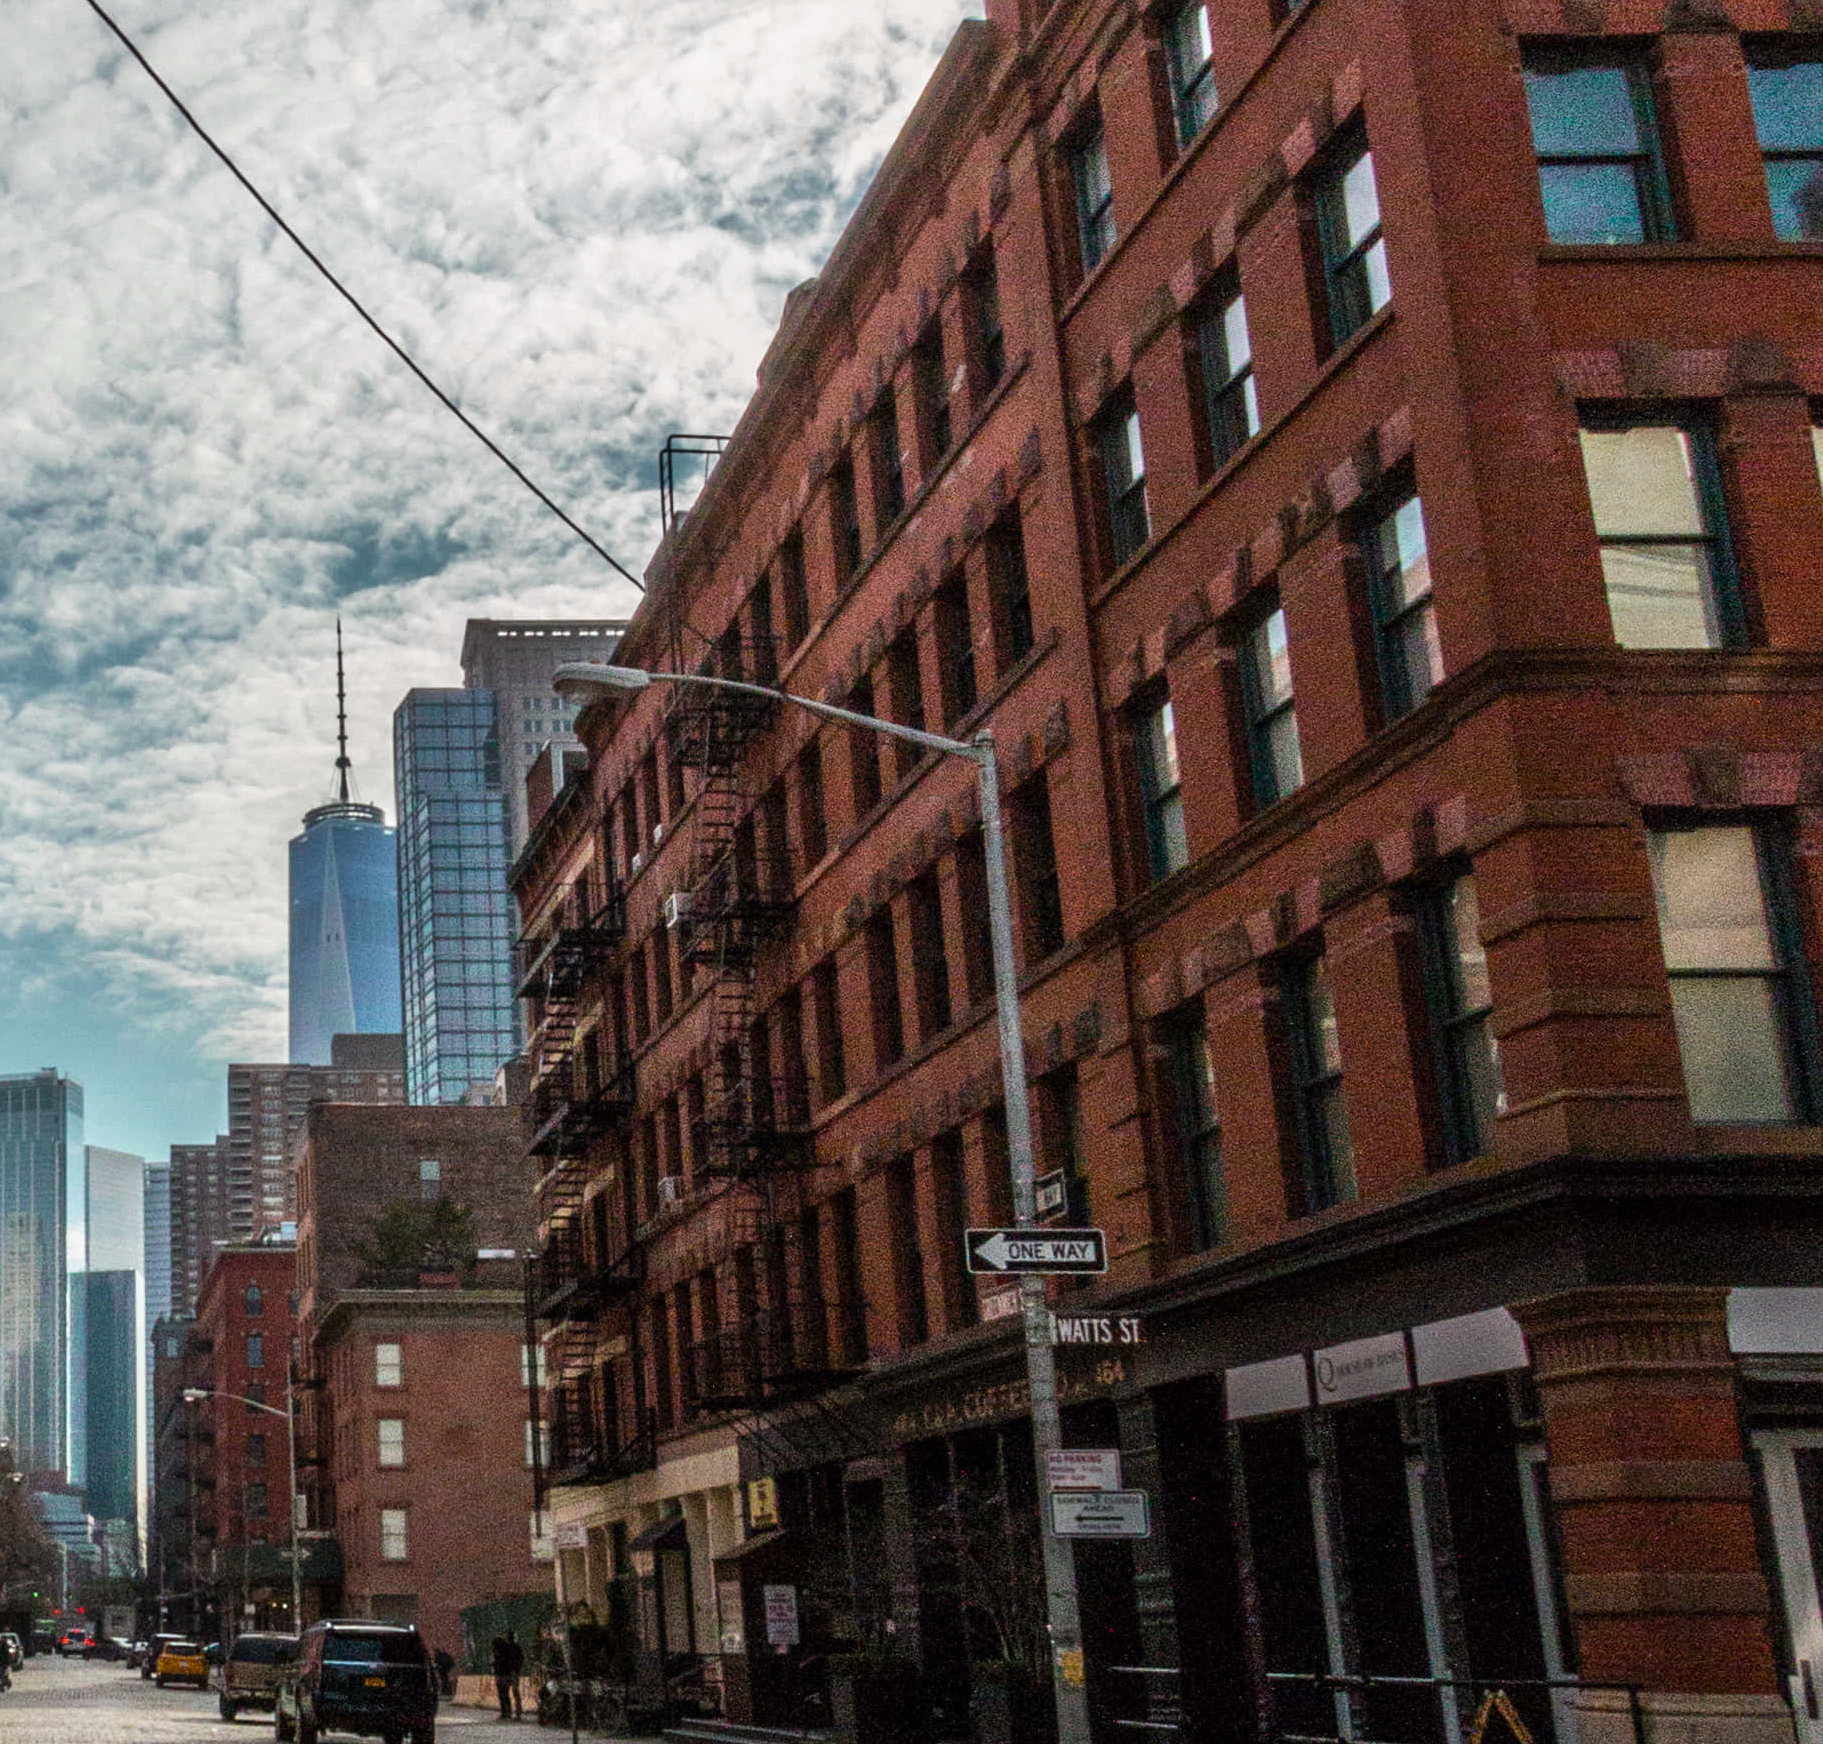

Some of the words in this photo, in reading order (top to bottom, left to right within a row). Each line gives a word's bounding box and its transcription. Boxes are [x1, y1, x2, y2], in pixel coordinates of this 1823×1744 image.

[1008, 1243, 1046, 1260] ONE
[1051, 1243, 1089, 1260] WAY
[1057, 1317, 1113, 1343] WATTS
[1118, 1317, 1140, 1343] ST
[1064, 1455, 1101, 1463] PARKING
